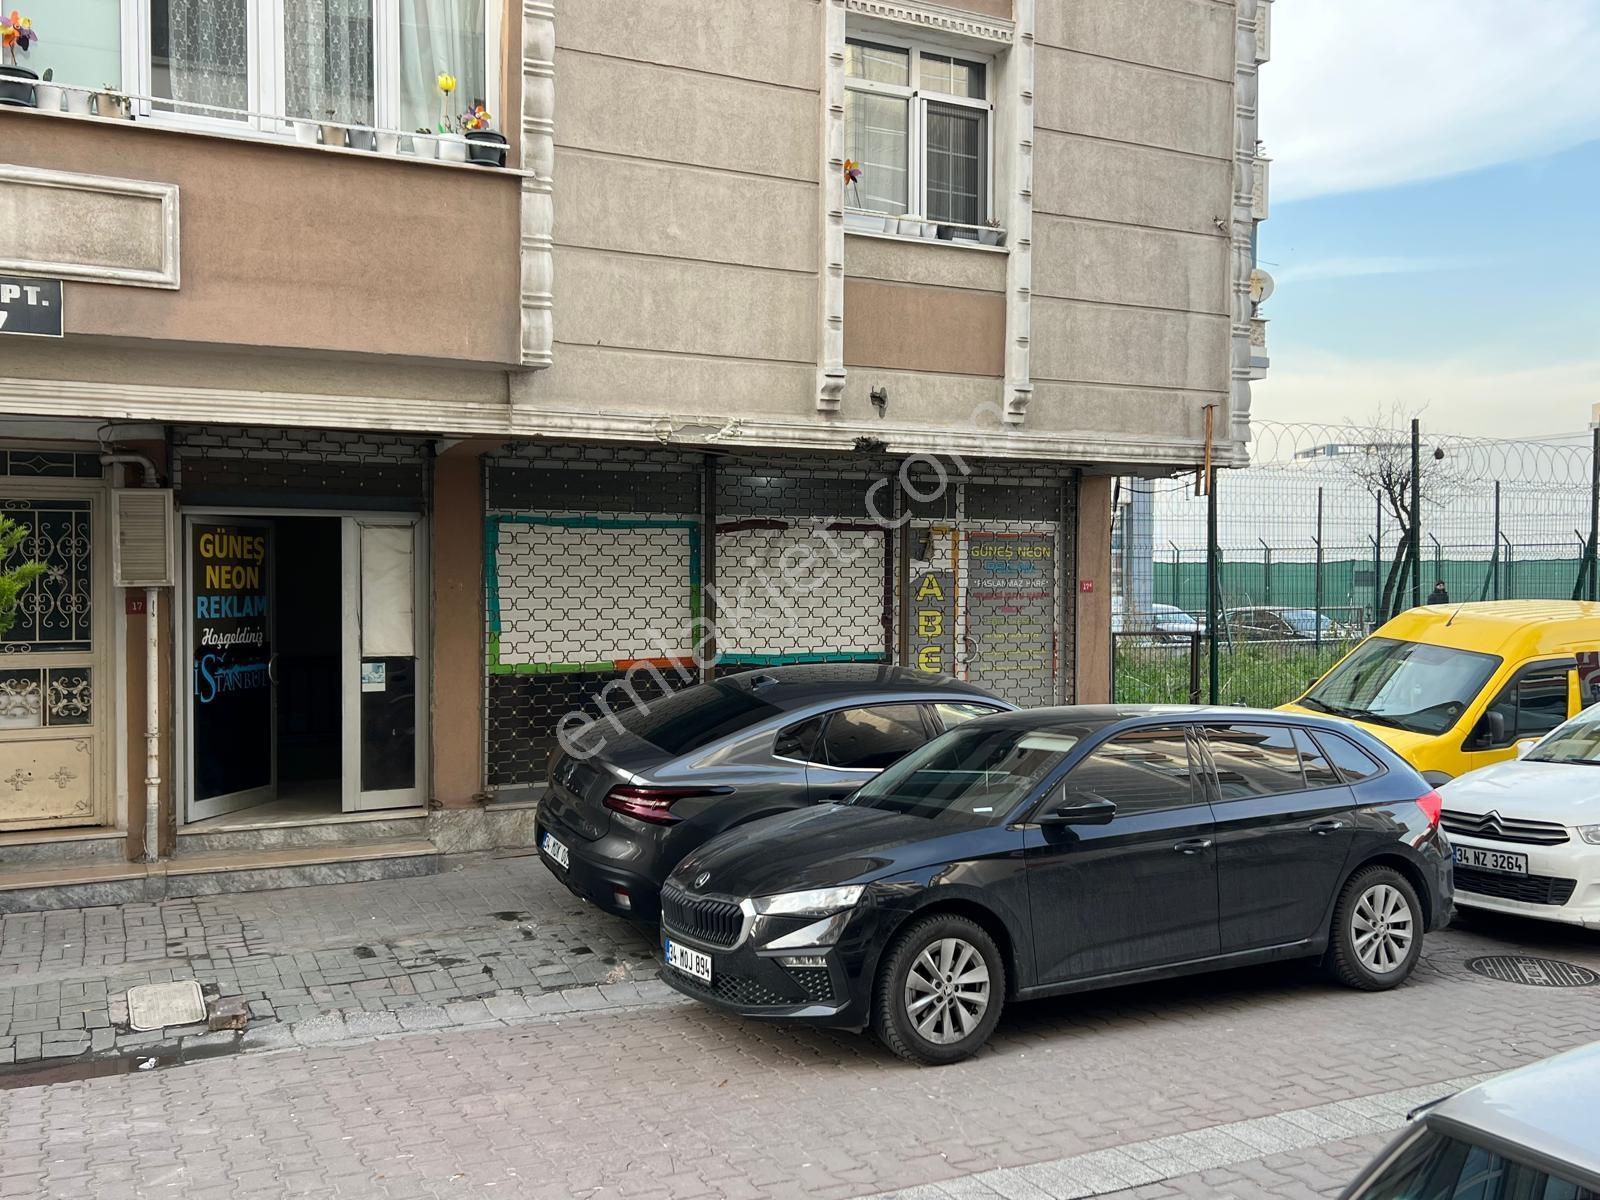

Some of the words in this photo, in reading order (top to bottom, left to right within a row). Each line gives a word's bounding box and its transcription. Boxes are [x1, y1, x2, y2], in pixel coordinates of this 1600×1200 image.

[0, 283, 50, 306] PT.
[200, 528, 265, 565] GÜNEŞ
[206, 565, 259, 589] NEON
[132, 601, 143, 611] 17
[196, 595, 267, 620] REKLAM
[1456, 848, 1469, 864] 34
[1473, 851, 1488, 867] NZ
[1491, 853, 1522, 872] 3264
[669, 944, 677, 964] 34
[679, 948, 693, 971] MOJ
[695, 955, 710, 978] 894
